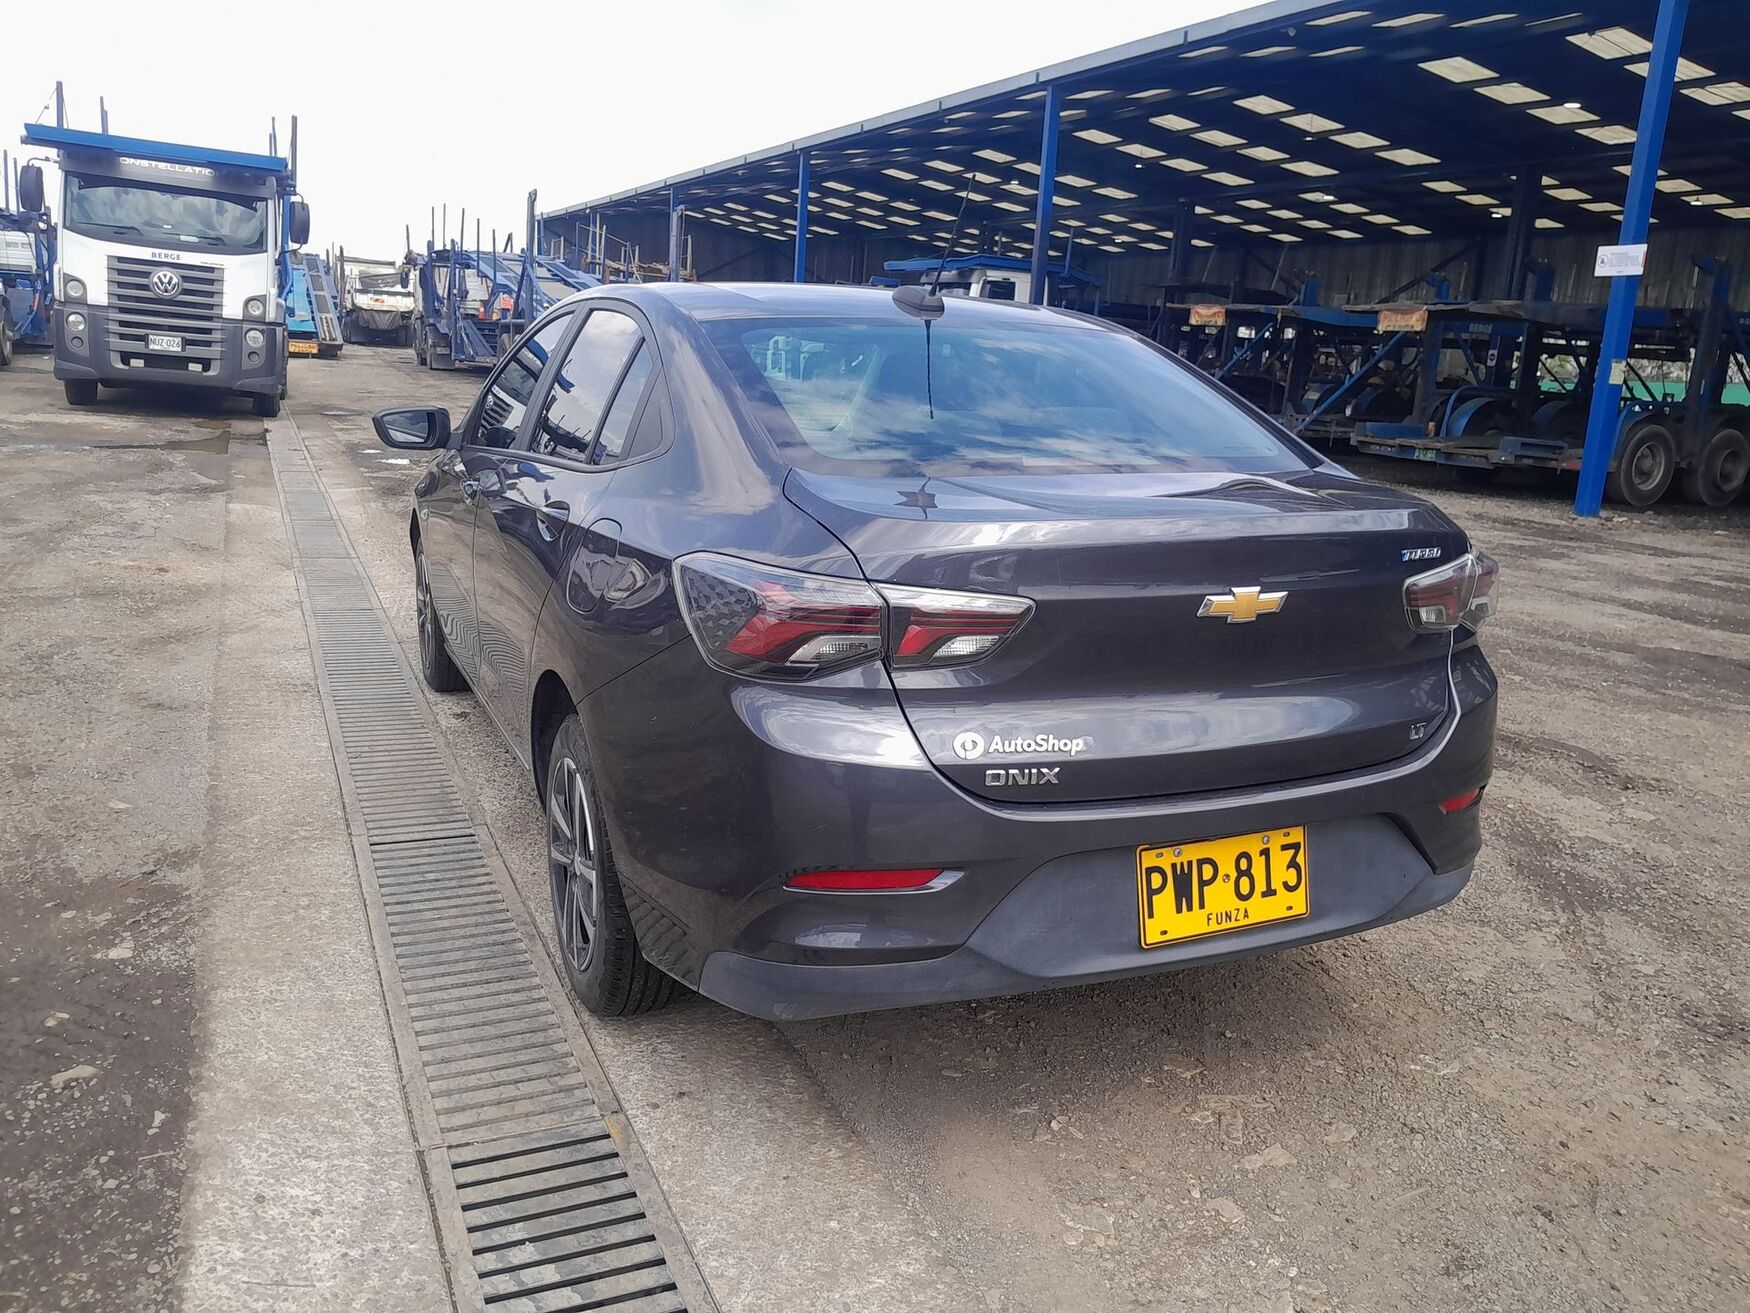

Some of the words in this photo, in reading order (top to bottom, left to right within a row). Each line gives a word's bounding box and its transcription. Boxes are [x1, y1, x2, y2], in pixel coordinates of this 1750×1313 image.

[119, 156, 215, 177] ONSTELLATIO
[151, 251, 182, 261] BERGE
[985, 767, 1061, 786] ONIX
[1206, 906, 1250, 927] FUNZA
